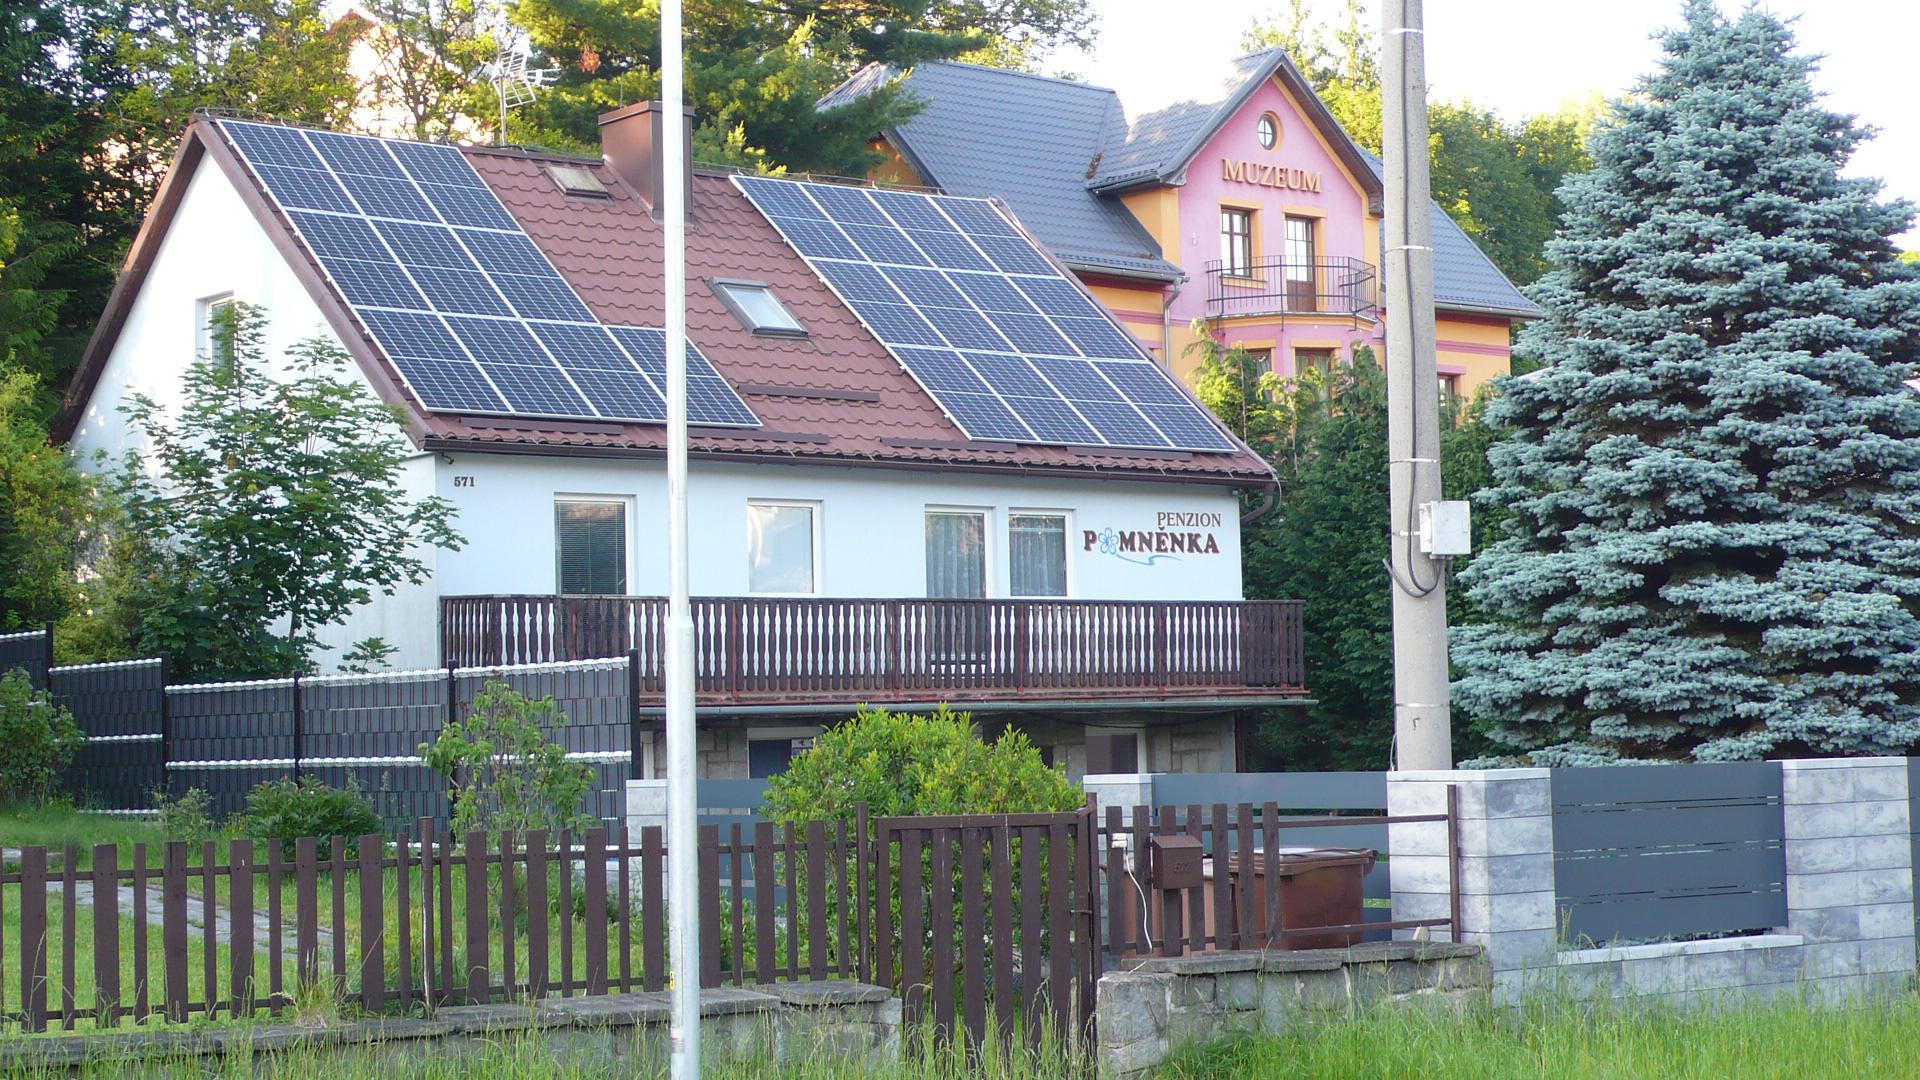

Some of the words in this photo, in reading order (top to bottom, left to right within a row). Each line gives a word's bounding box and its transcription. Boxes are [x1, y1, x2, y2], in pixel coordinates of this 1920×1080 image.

[1222, 158, 1321, 193] MUZEUM
[454, 476, 474, 487] 571
[1157, 511, 1221, 527] PENZION
